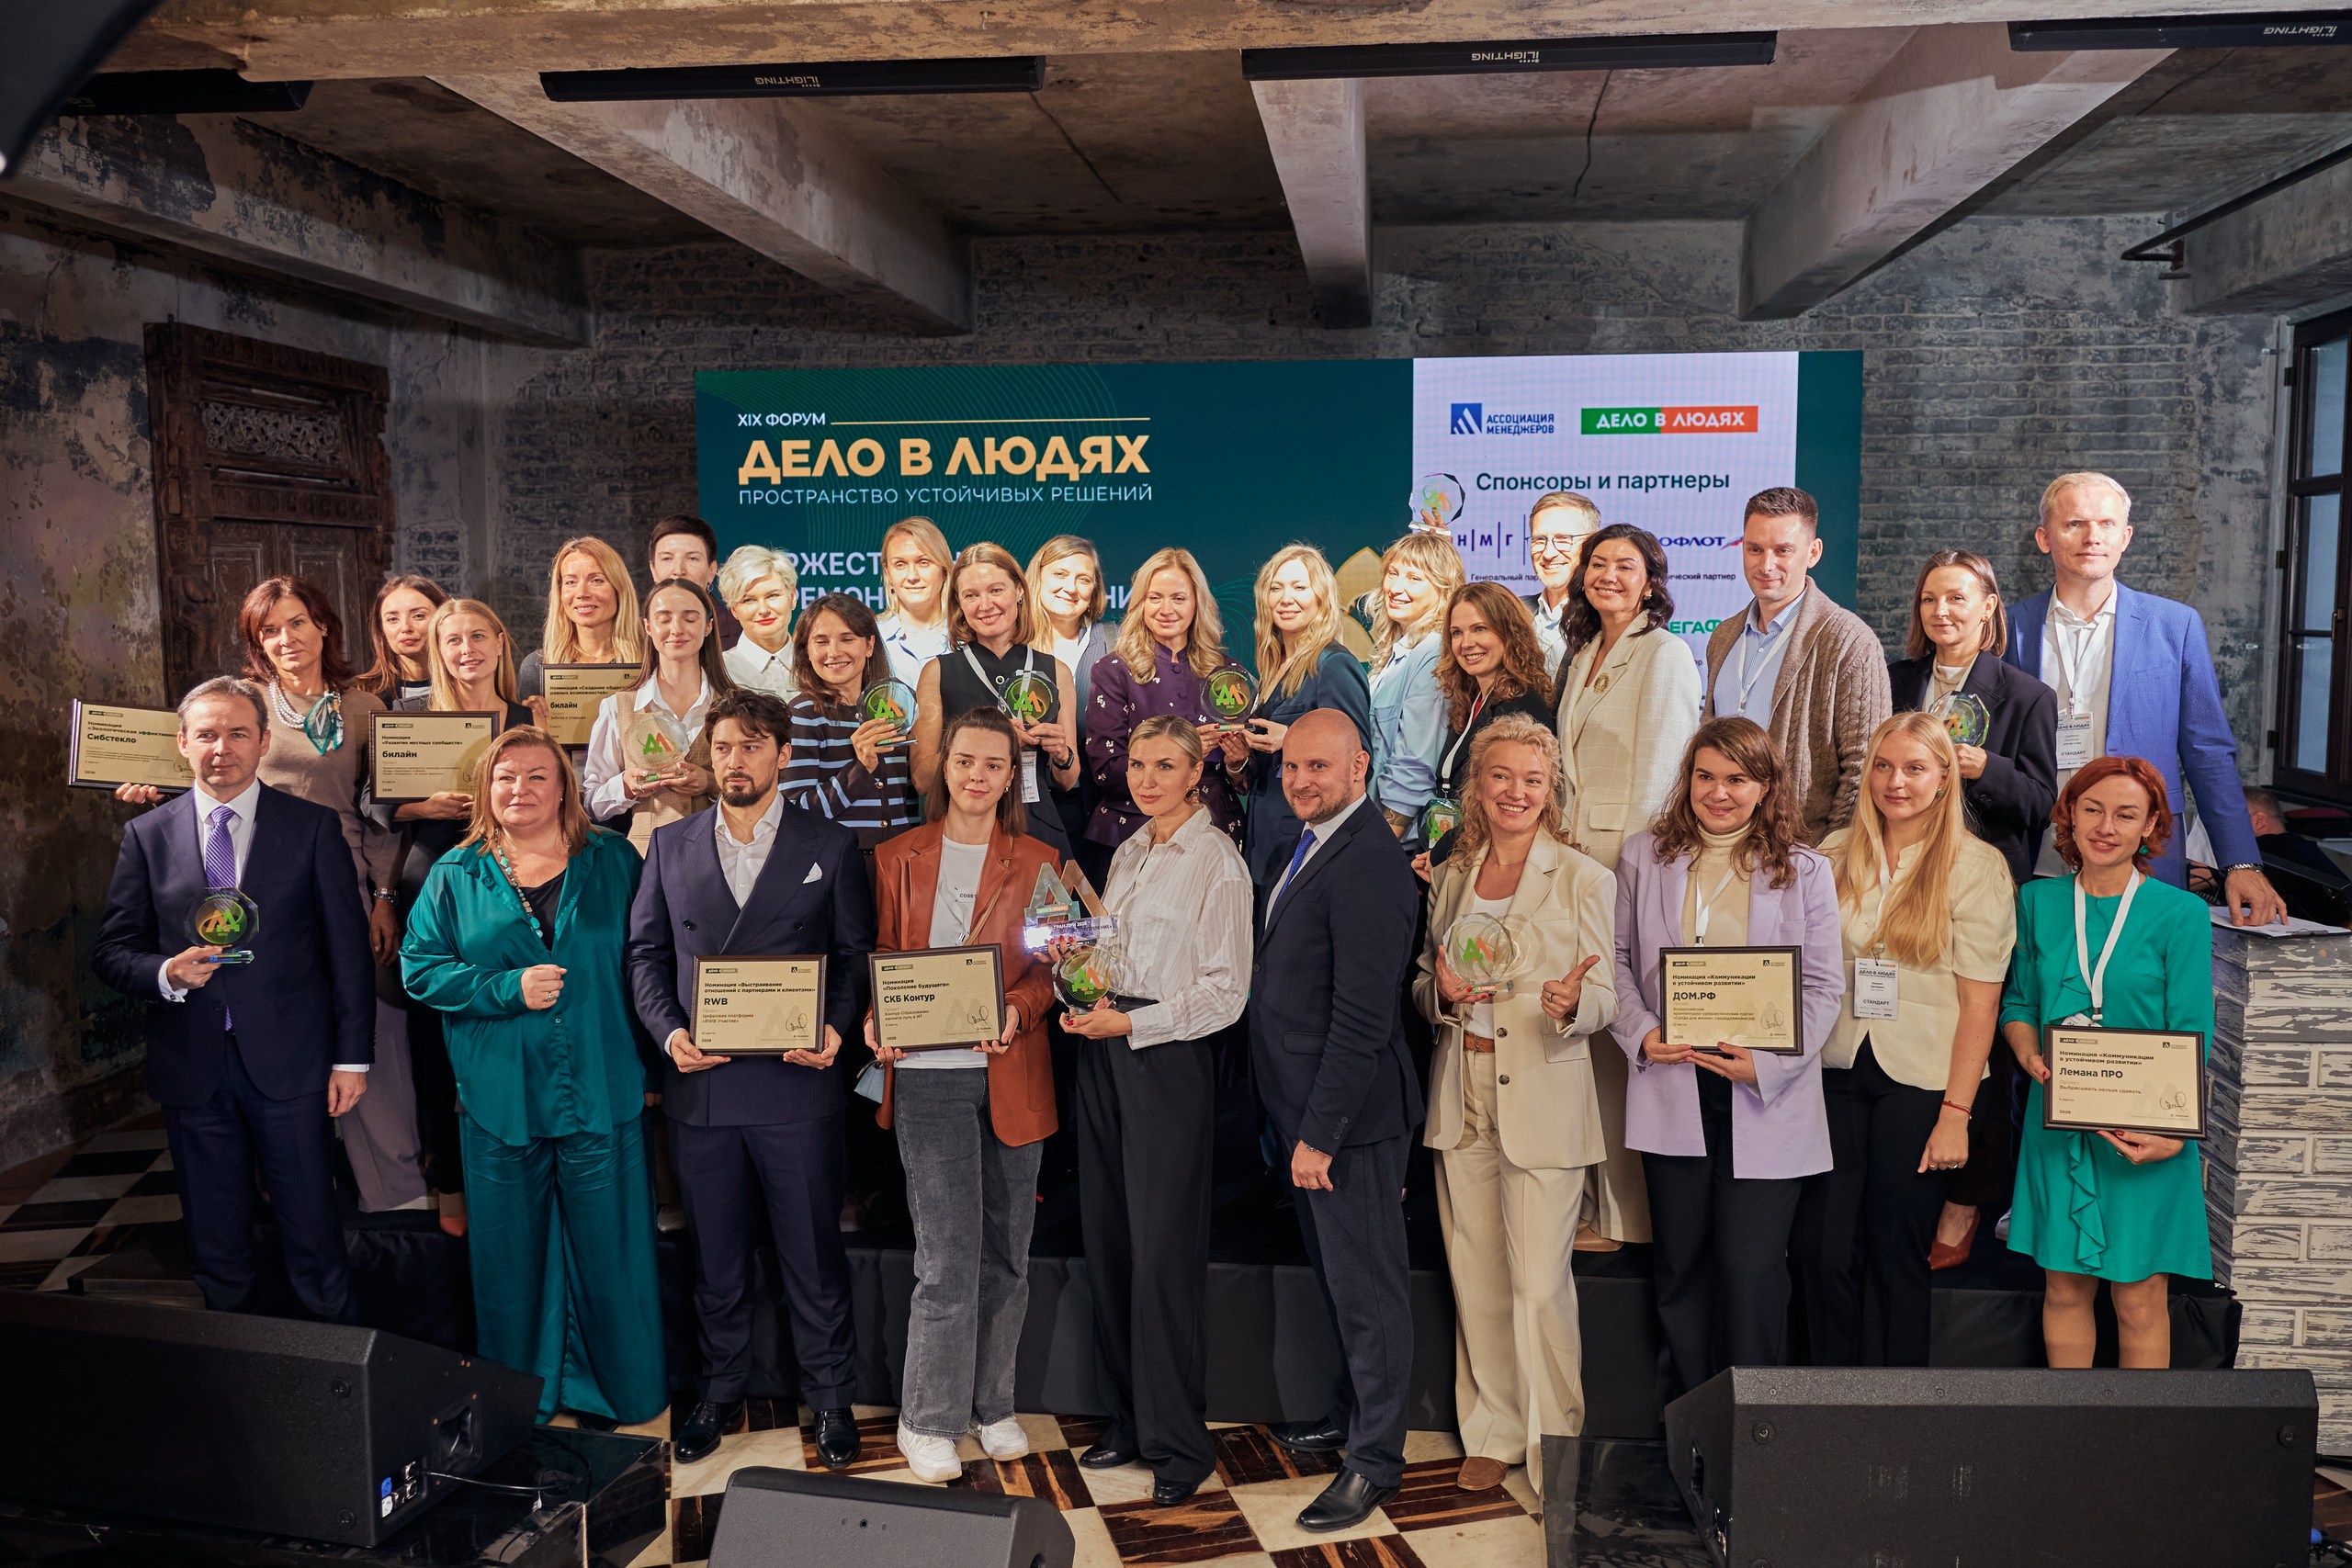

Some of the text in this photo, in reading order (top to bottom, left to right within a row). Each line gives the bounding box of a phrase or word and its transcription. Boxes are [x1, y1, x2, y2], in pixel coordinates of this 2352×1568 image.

[738, 412, 826, 427] XIX ФОРУМ
[1487, 413, 1555, 424] АССОЦИАЦИЯ
[1596, 412, 1745, 429] ДЕЛО В ЛЮДЯХ
[1487, 424, 1555, 435] МЕНЕДЖЕРОВ
[739, 434, 1151, 485] ДЕЛО В ЛЮДЯХ
[1476, 472, 1730, 492] Спонсоры и партнеры
[740, 483, 1153, 505] ПРОСТРАНСТВО УСТОЙЧИВЫХ РЕШЕНИЙ
[1471, 573, 1523, 582] Генеральный
[1702, 573, 1736, 581] партнер
[549, 701, 578, 709] билайн
[86, 733, 137, 744] Сибстекло
[884, 993, 935, 1003] СКБ Контур
[1672, 991, 1716, 1001] ДОМ.РФ
[704, 998, 729, 1006] RWB
[2098, 1052, 2154, 1061] «Коммуникации
[2059, 1067, 2123, 1078] Лемана ПРО
